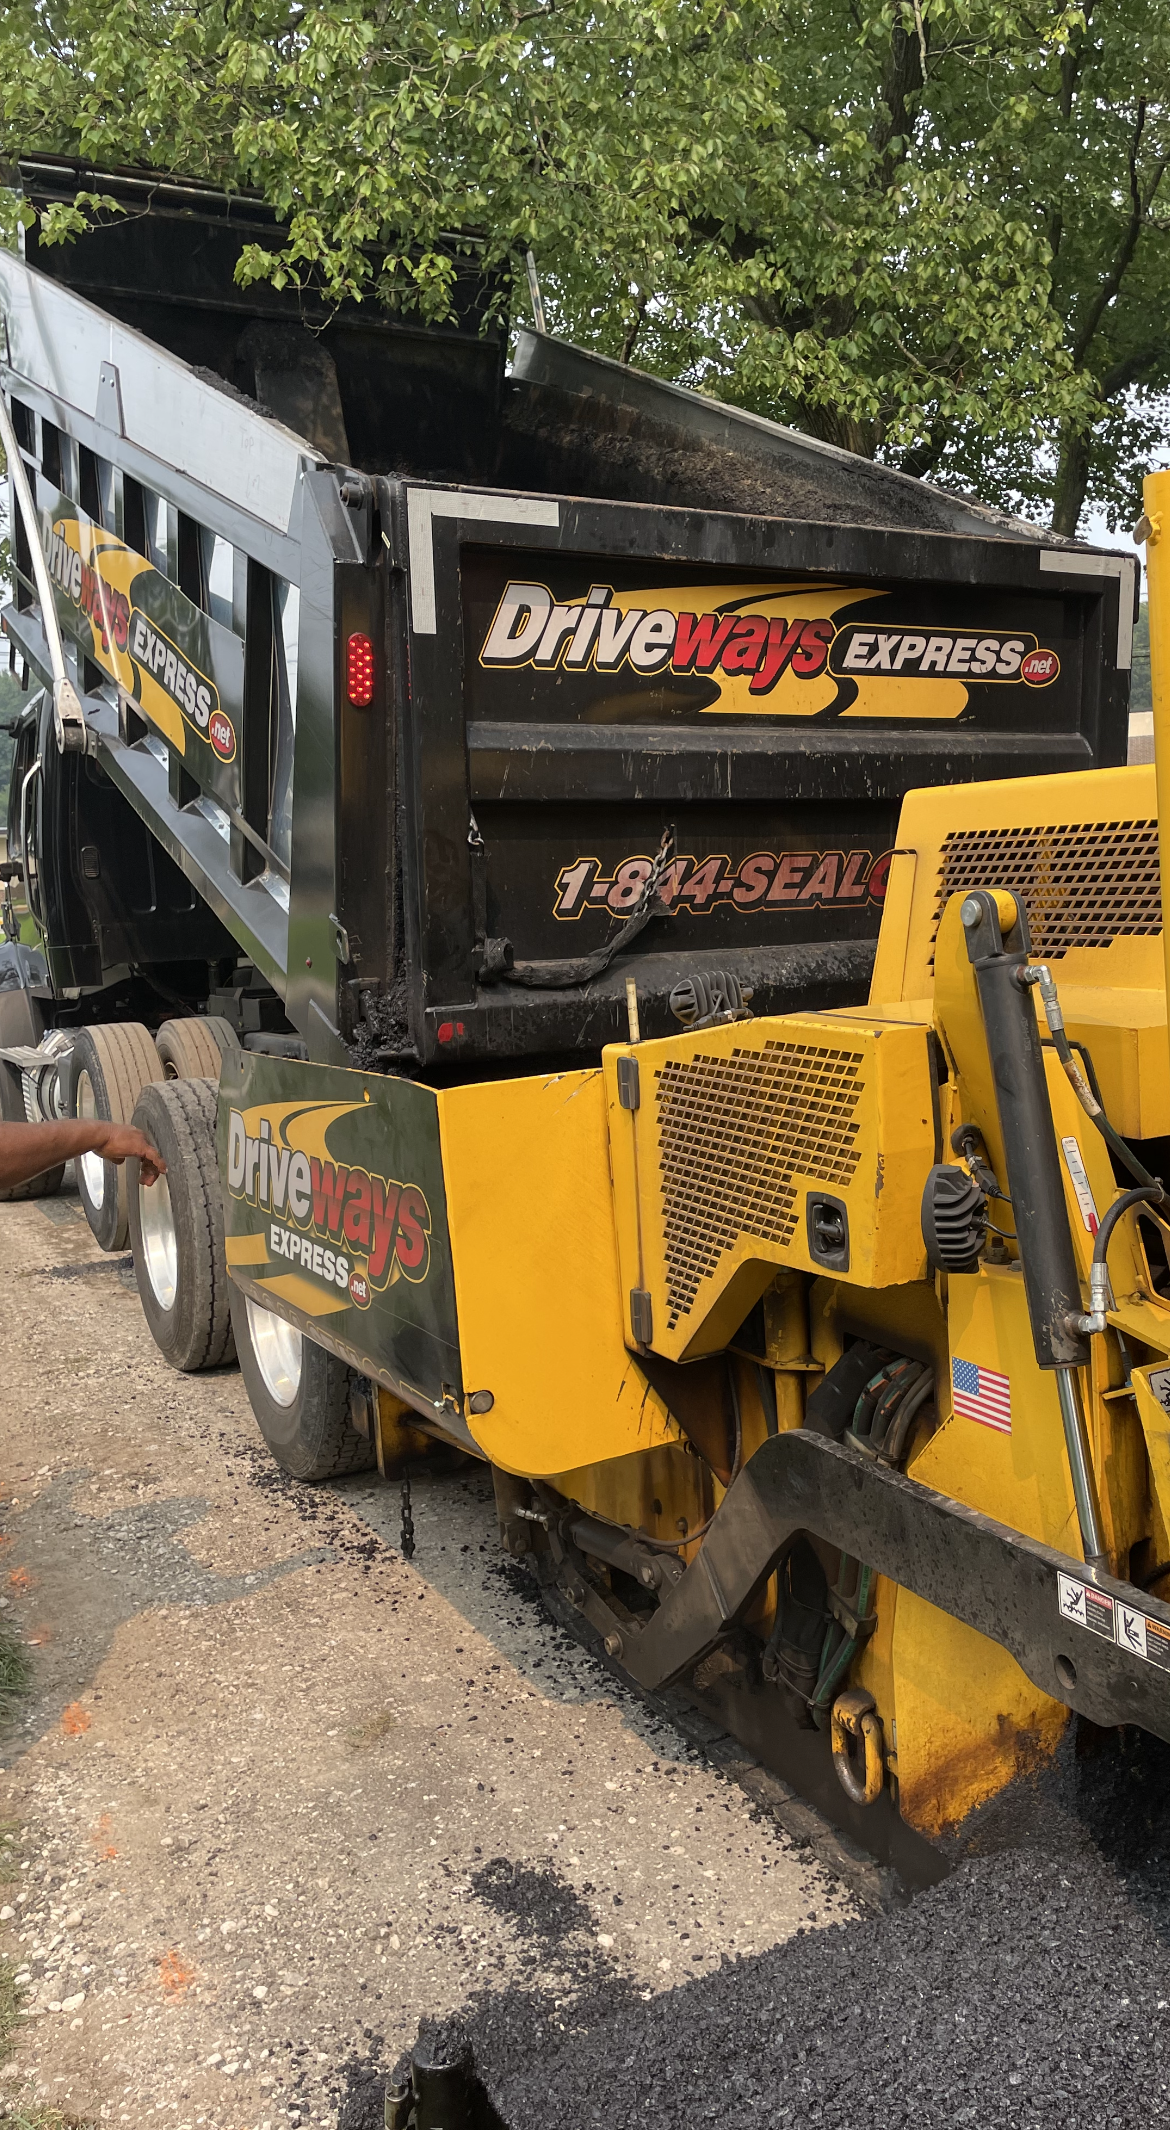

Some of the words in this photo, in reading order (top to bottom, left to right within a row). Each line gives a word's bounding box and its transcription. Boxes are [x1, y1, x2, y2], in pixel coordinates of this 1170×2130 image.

[41, 507, 129, 650] Driveways
[132, 622, 212, 729] EXPRESS
[211, 719, 231, 750] .net
[481, 582, 833, 689] Driveways
[844, 632, 1025, 675] EXPRESS
[1024, 656, 1053, 674] .net
[228, 1108, 427, 1277] Driveways
[269, 1223, 349, 1289] EXPRESS
[350, 1278, 367, 1298] .net
[1091, 1592, 1111, 1607] DANGER
